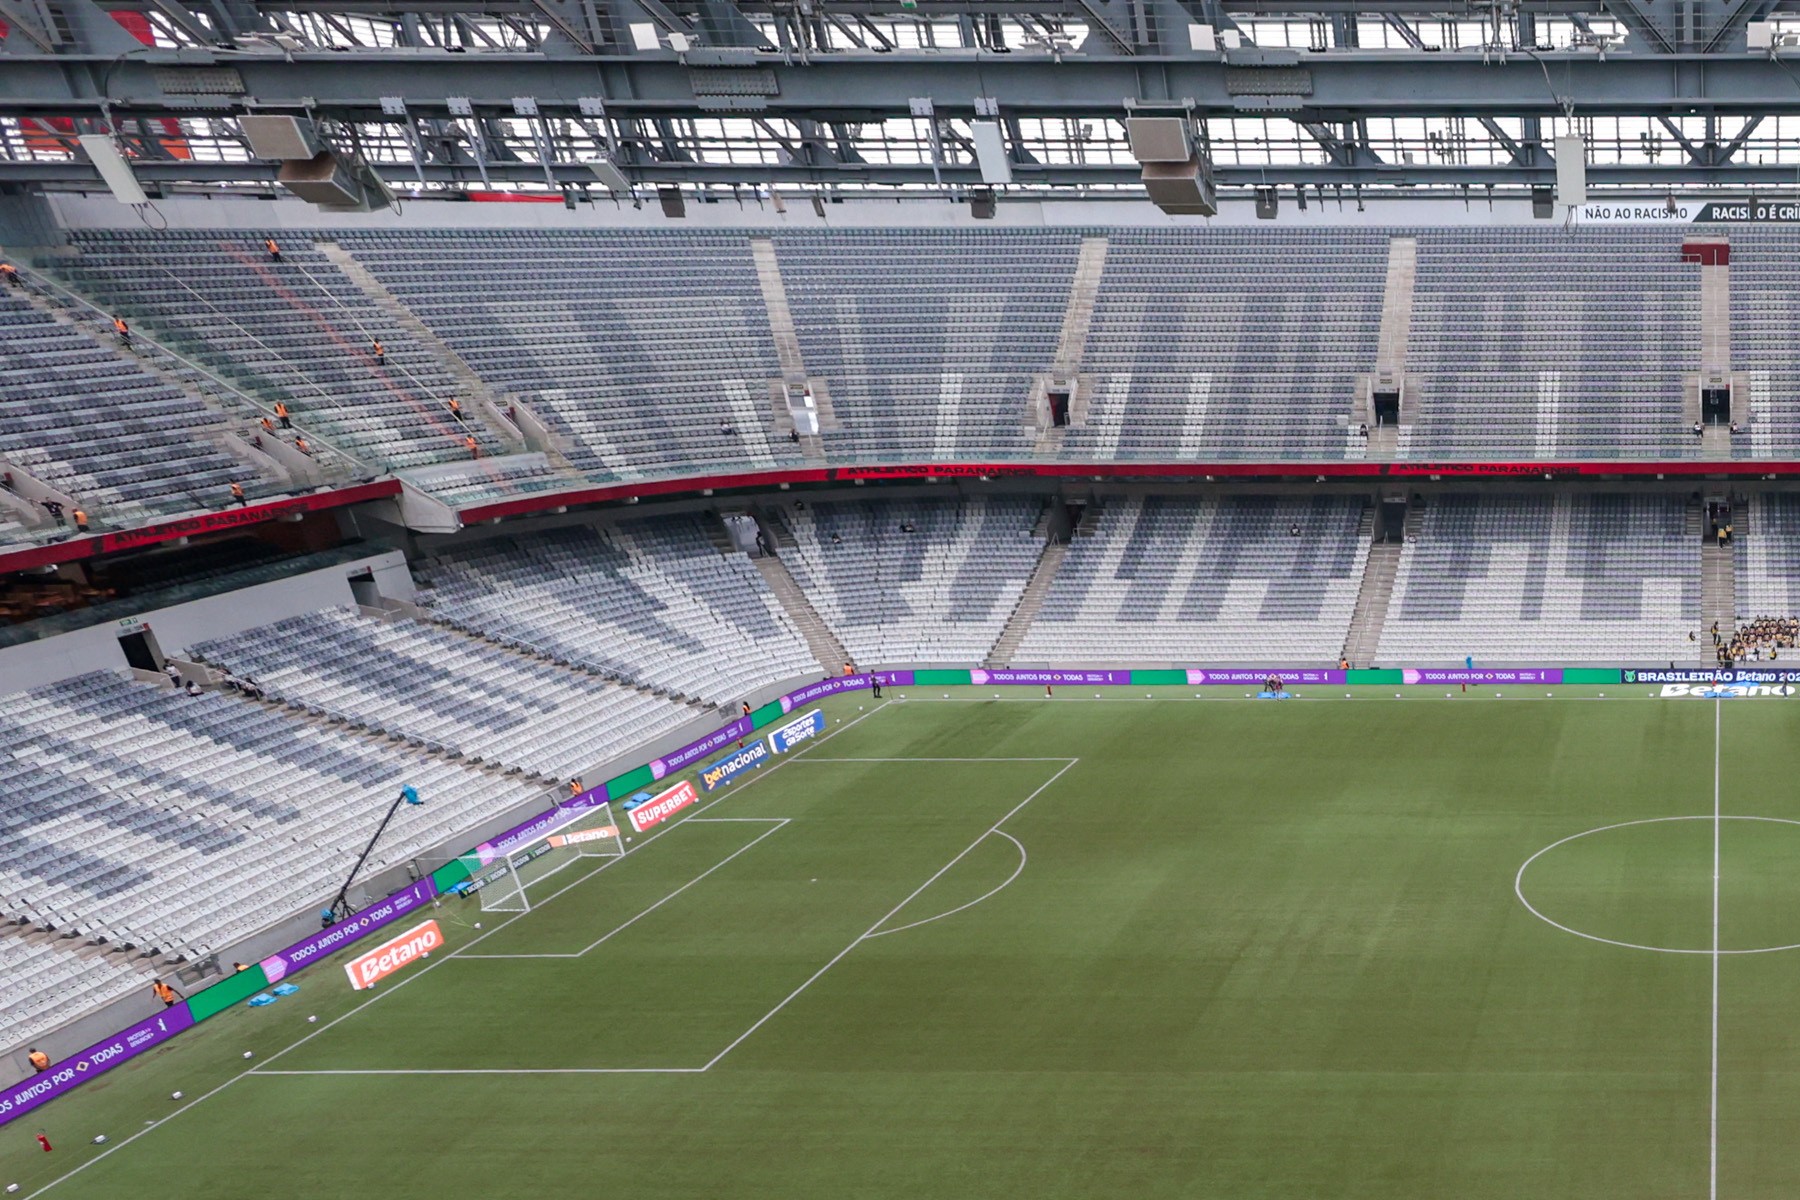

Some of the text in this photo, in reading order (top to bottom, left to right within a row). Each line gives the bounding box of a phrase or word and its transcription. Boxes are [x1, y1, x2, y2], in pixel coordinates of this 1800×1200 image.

[1585, 205, 1688, 219] NÃO AO RACISMO
[1712, 207, 1766, 219] RACISO
[1769, 204, 1776, 219] É
[1638, 670, 1733, 682] BRASILEIRÃO
[1736, 671, 1776, 682] Betano
[703, 744, 766, 788] betnacional
[638, 786, 693, 825] SUPERBET
[290, 944, 317, 962] TODOS
[343, 922, 359, 937] POR
[369, 905, 393, 922] TODAS
[360, 931, 436, 982] Betano
[15, 1080, 52, 1105] JUNTOS
[52, 1068, 75, 1086] POR
[90, 1043, 124, 1065] TODAS
